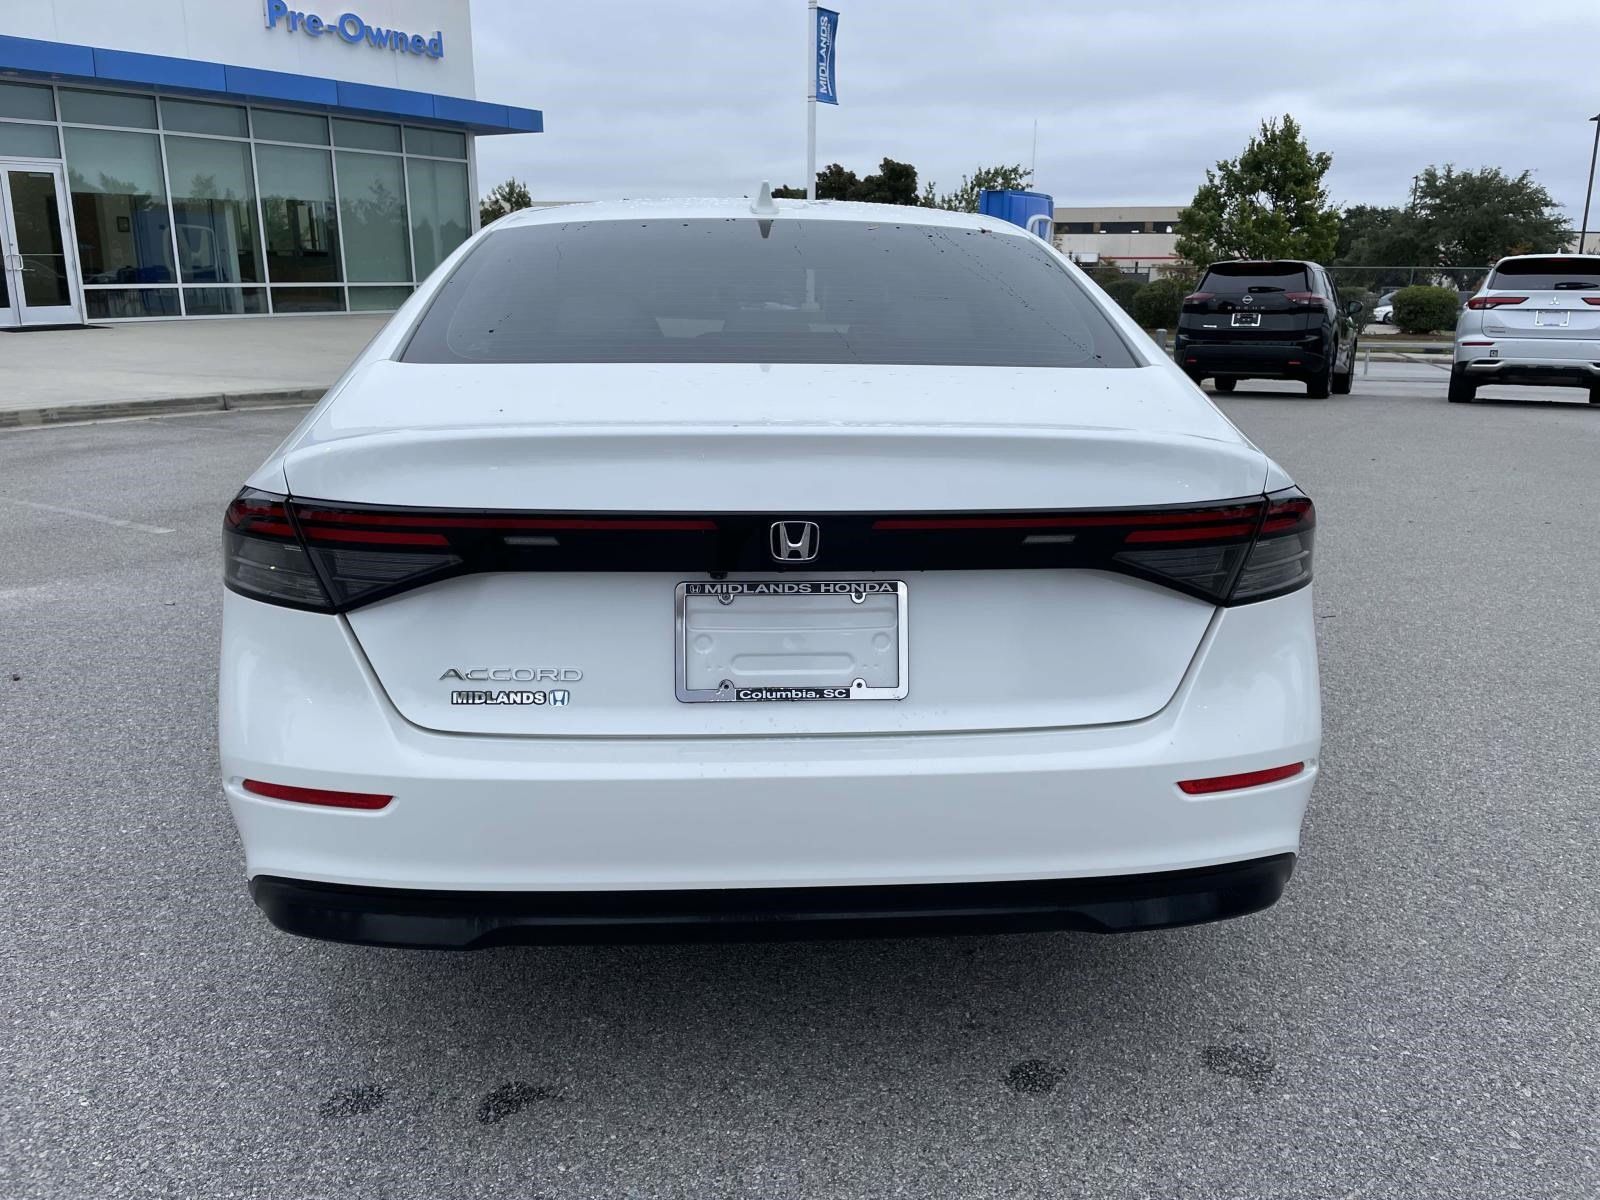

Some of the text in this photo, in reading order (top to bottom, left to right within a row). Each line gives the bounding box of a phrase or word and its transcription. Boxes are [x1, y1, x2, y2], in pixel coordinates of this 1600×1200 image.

[264, 0, 444, 58] Pre-Owned
[819, 15, 829, 94] MIDLANDS
[704, 583, 812, 593] MIDLANDS
[820, 582, 893, 593] HONDA
[439, 668, 583, 681] ACCORD
[452, 691, 546, 705] MIDLANDS
[739, 688, 847, 699] Columbia, SC
